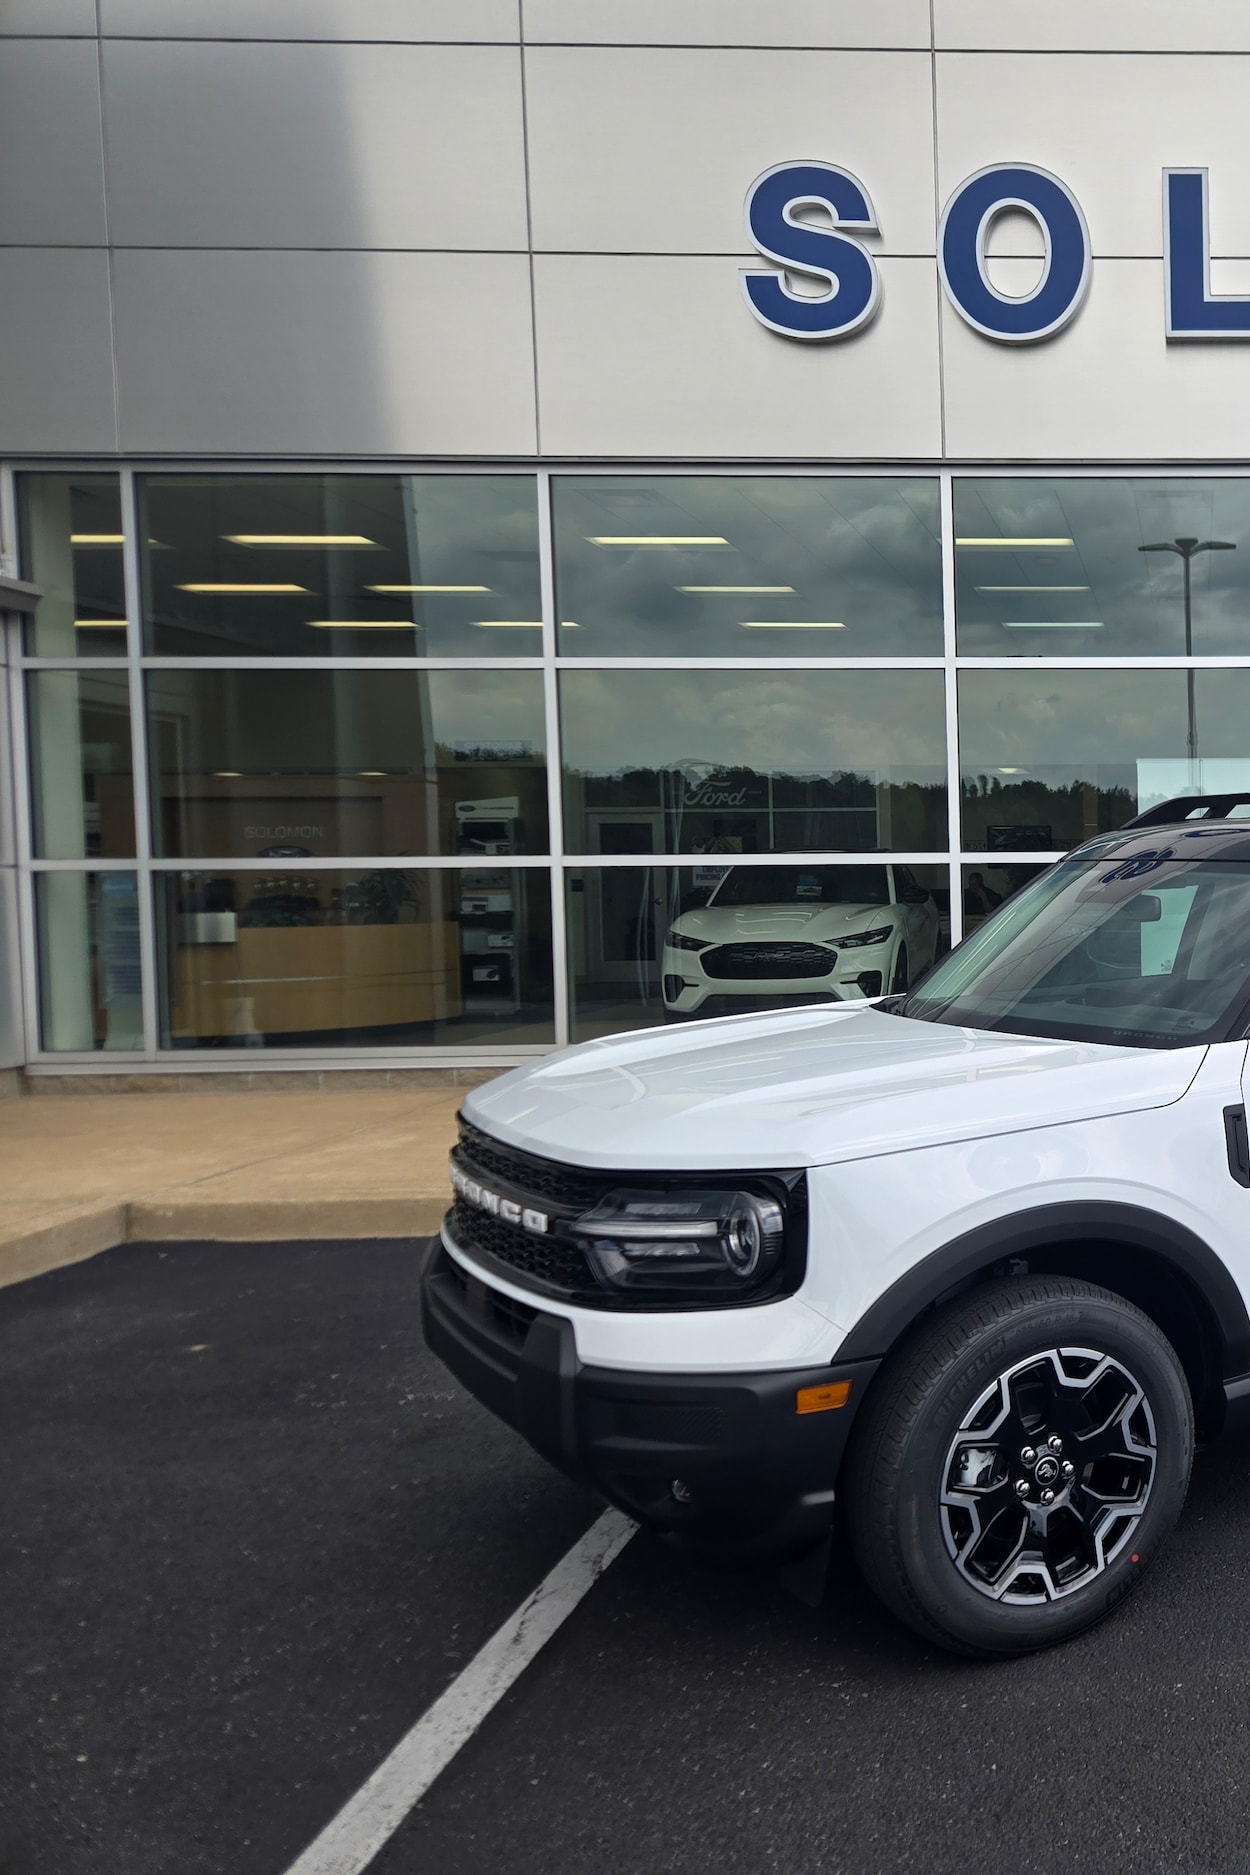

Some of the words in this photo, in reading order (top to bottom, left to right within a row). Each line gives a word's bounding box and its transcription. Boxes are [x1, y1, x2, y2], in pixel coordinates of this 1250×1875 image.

[684, 779, 747, 806] Ford
[244, 825, 324, 839] SOLOMON
[931, 1335, 1008, 1427] MICHELIN
